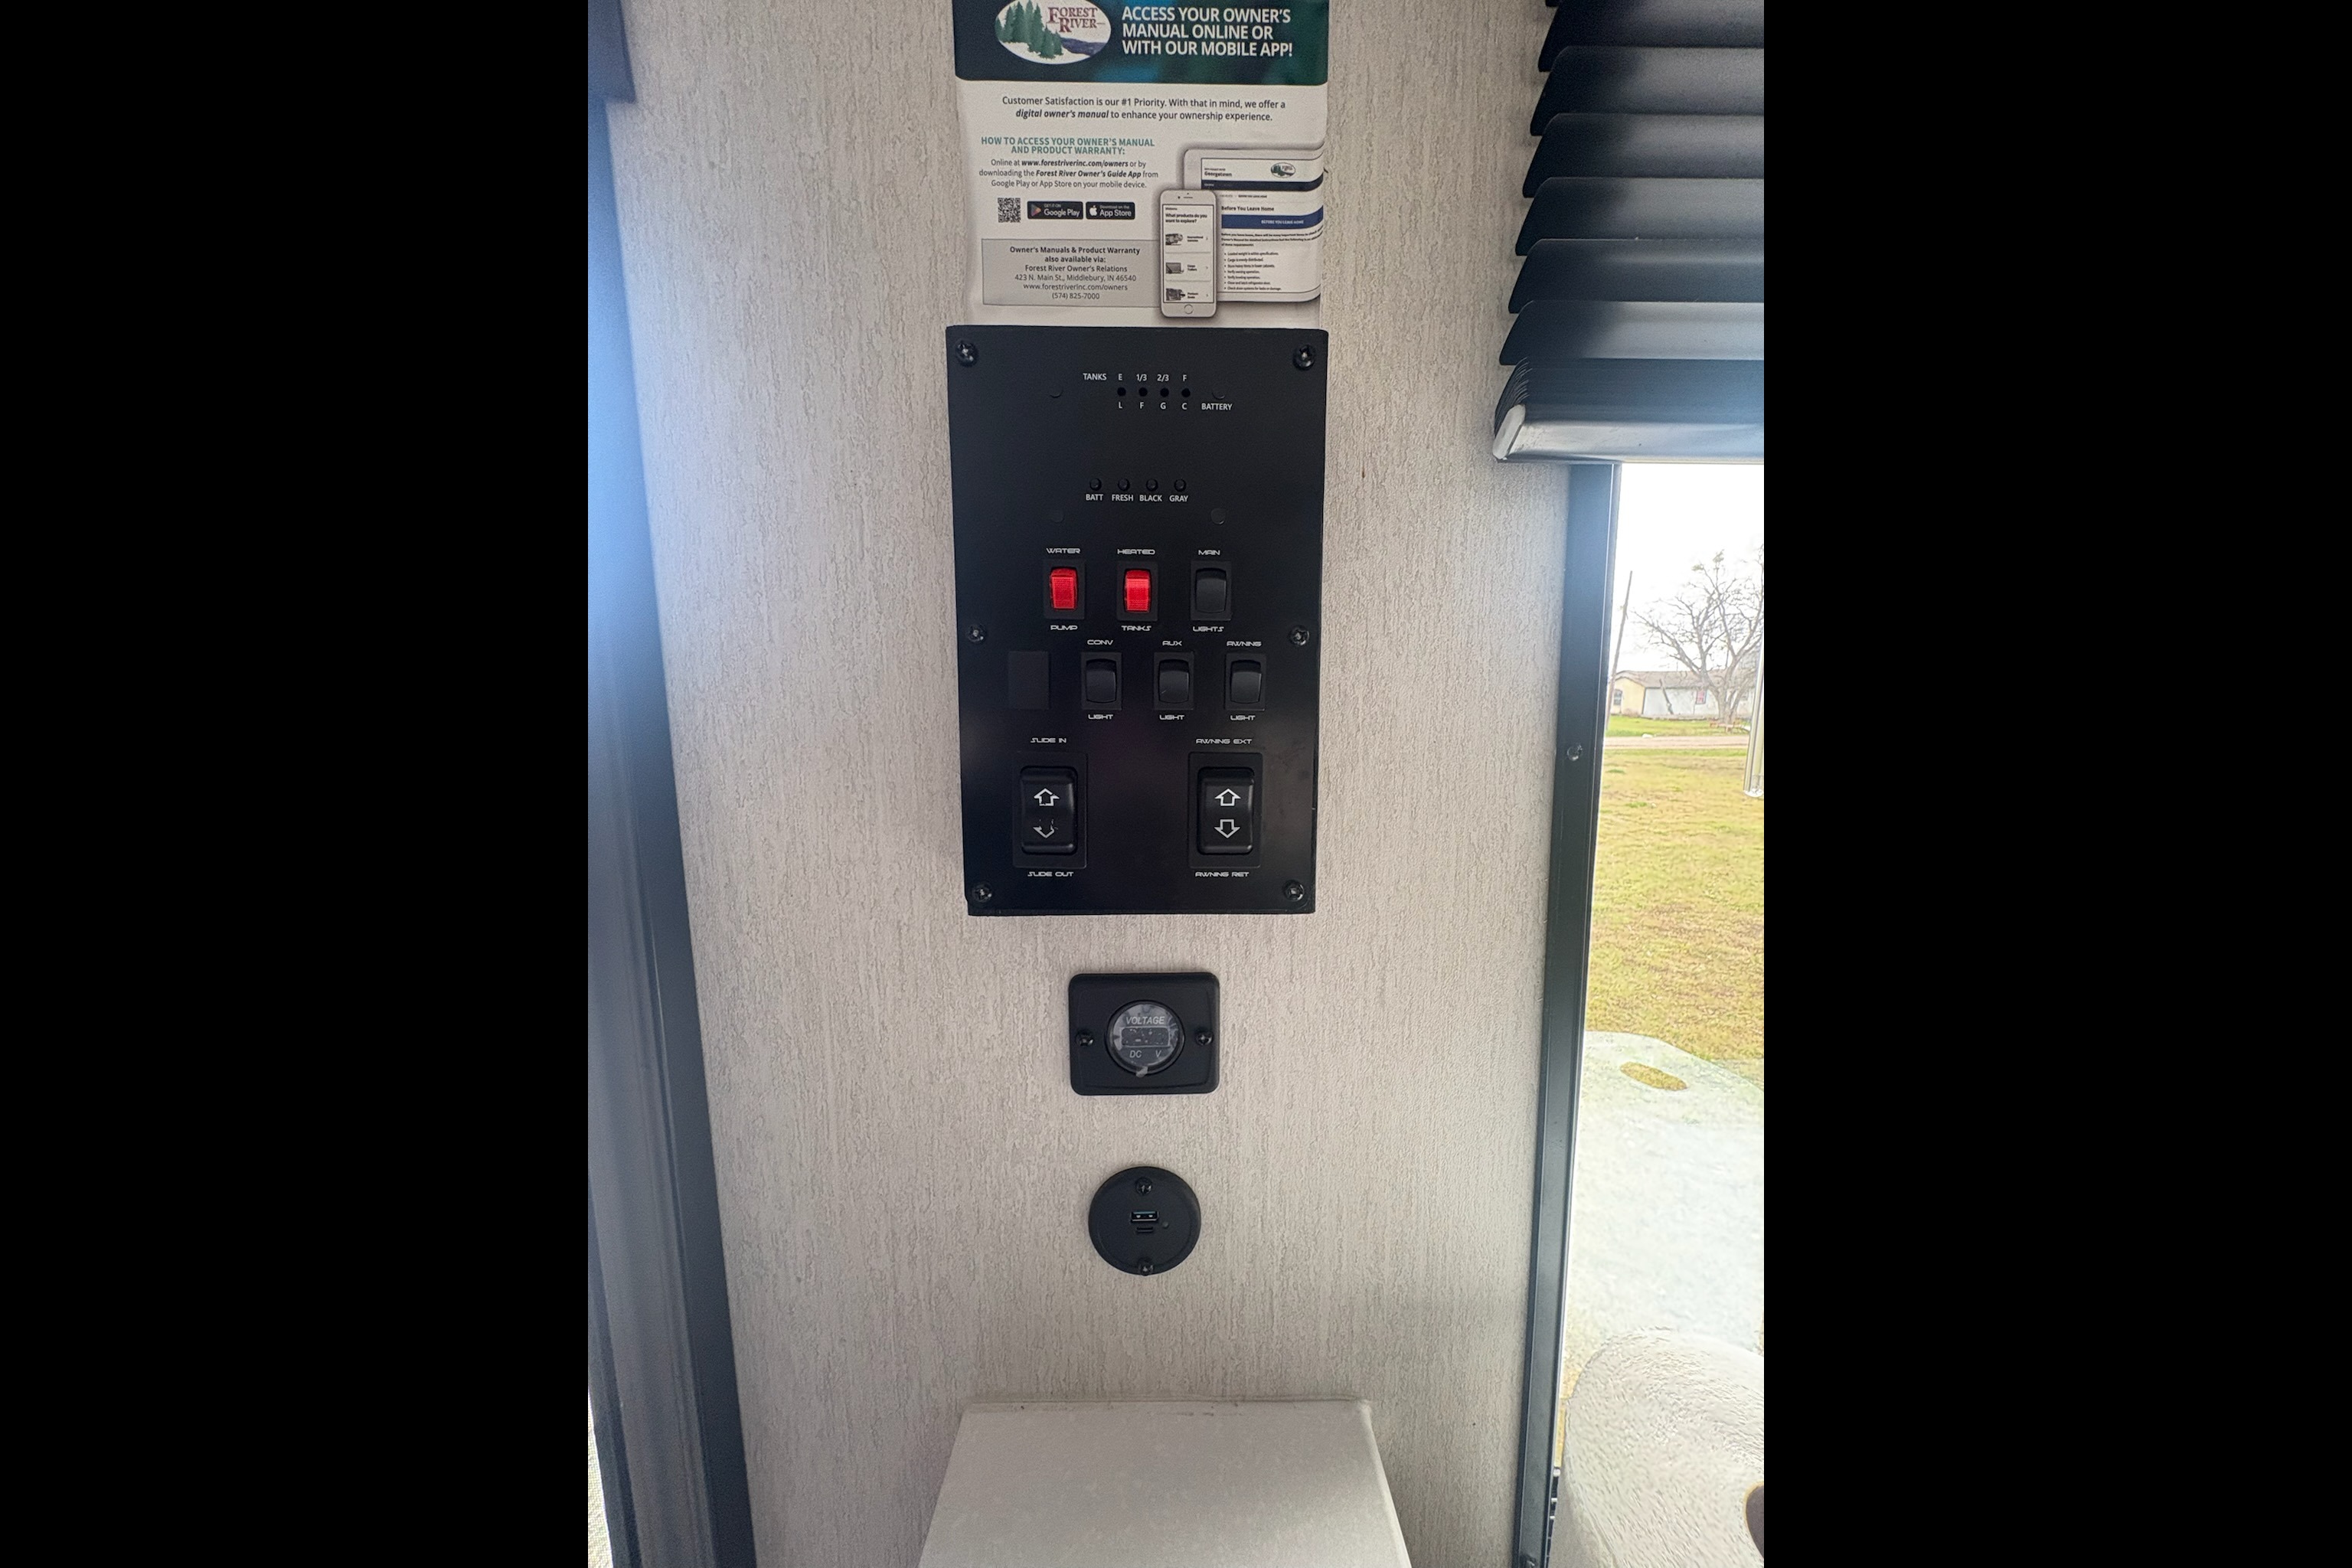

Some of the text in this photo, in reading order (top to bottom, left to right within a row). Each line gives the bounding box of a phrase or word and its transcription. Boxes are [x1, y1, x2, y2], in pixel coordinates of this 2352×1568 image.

[1048, 7, 1098, 23] FOREST
[1122, 7, 1291, 23] ACCESS YOUR OWNER'S
[1058, 18, 1097, 32] RIVER
[1122, 23, 1273, 40] MANUAL ONLINE OR
[1122, 41, 1292, 57] WITH OUR MOBILE APP!
[1002, 96, 1043, 105] Customer
[1045, 97, 1094, 106] Satisfaction
[1134, 98, 1167, 109] Priority.
[1191, 99, 1207, 107] that
[1219, 100, 1243, 109] mind,
[1016, 109, 1042, 119] digital
[1122, 110, 1156, 119] enhance
[1158, 112, 1178, 121] your
[1180, 112, 1223, 122] ownership
[1225, 113, 1272, 122] experience.
[982, 137, 1002, 145] HOW
[1004, 137, 1015, 145] TO
[1052, 138, 1075, 146] YOUR
[1119, 139, 1155, 147] MANUAL
[1074, 147, 1125, 155] WARRANTY:
[1021, 159, 1129, 168] www.forestriverinc.com/owners
[1138, 160, 1146, 168] by
[979, 169, 1022, 178] downloading
[1128, 171, 1142, 179] App
[991, 180, 1014, 188] Google
[1016, 180, 1030, 188] Play
[1040, 180, 1053, 189] App
[1067, 209, 1080, 217] Play
